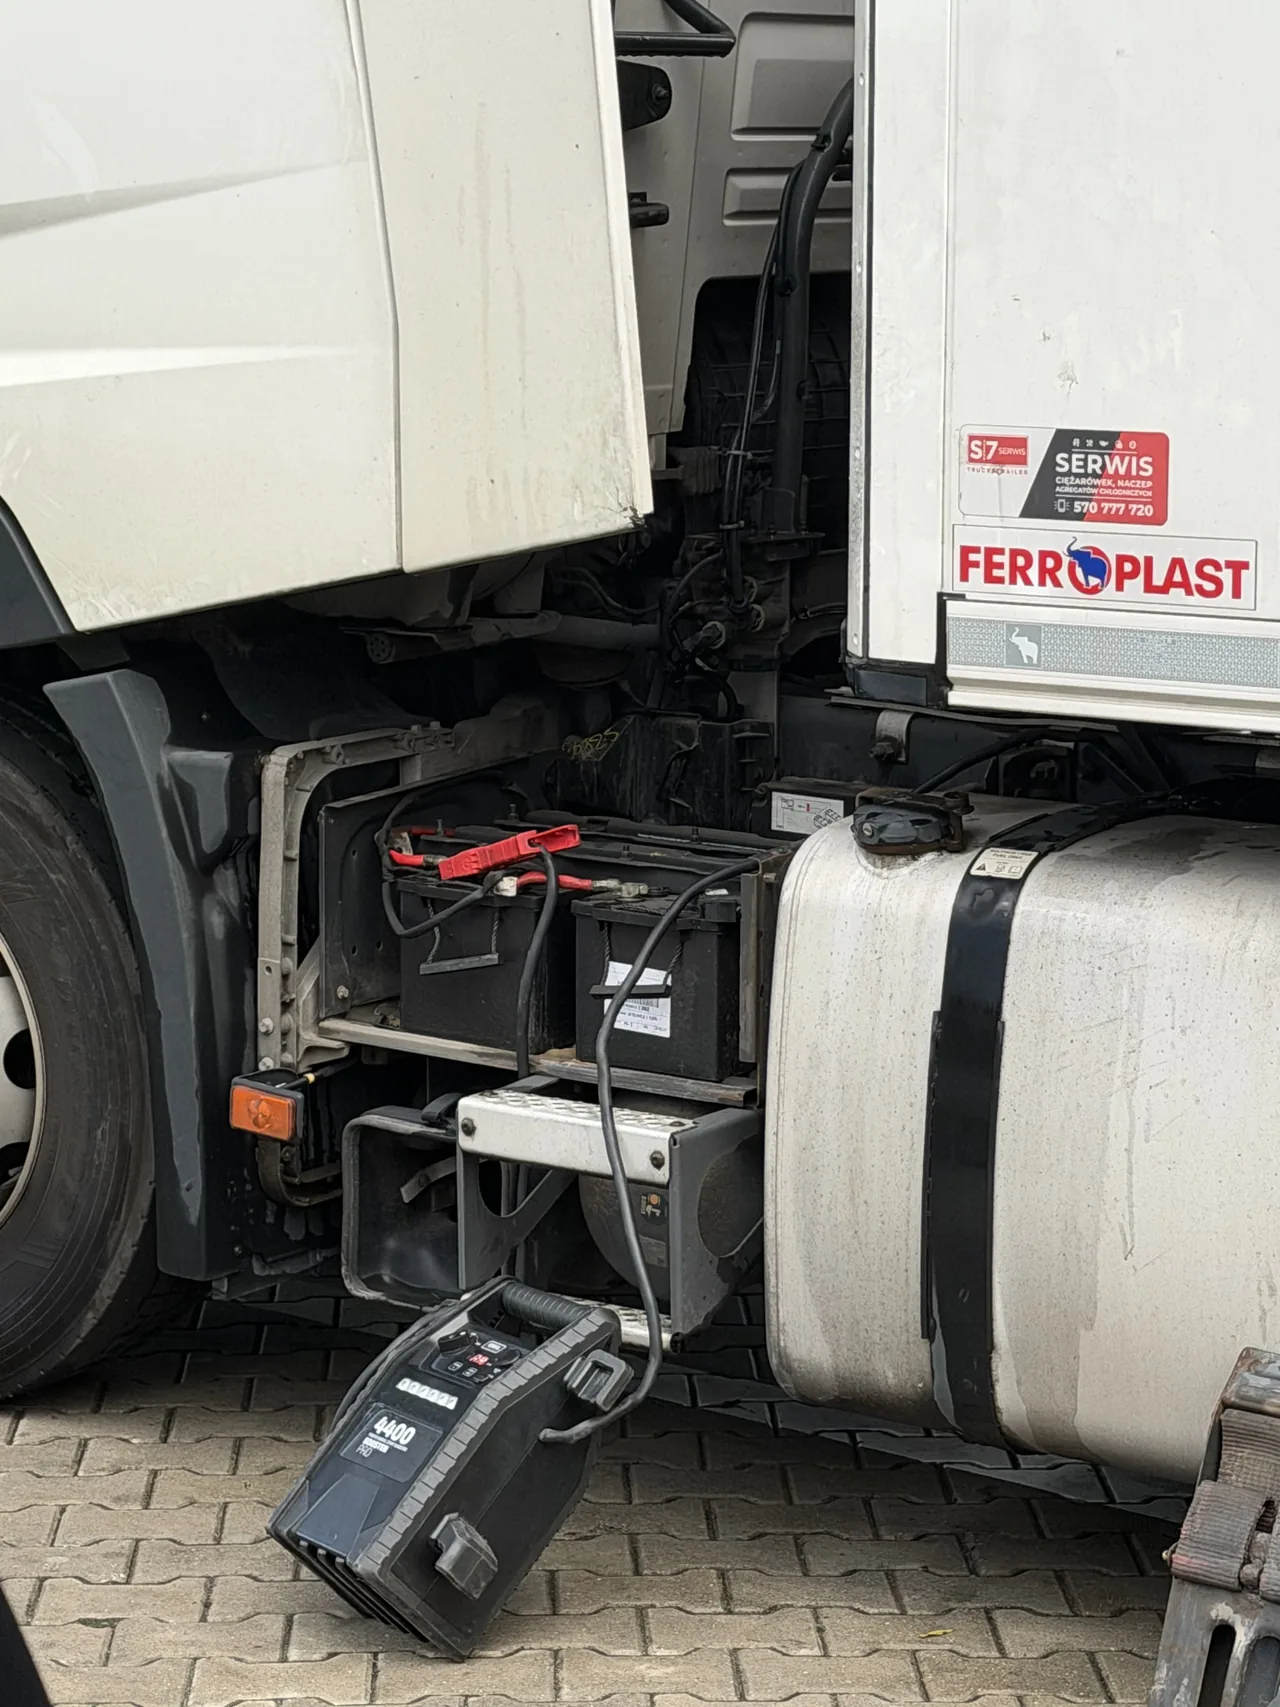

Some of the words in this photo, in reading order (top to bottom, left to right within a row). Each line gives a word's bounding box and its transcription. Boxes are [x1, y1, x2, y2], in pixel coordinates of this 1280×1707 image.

[998, 447, 1026, 456] SERWIS
[1054, 452, 1154, 477] SERWIS
[1117, 479, 1153, 488] NACZEP
[1073, 500, 1098, 514] 570
[1100, 502, 1126, 516] 777
[1128, 503, 1154, 517] 720
[958, 543, 1251, 600] FERROPLAST
[373, 1415, 417, 1446] 4400
